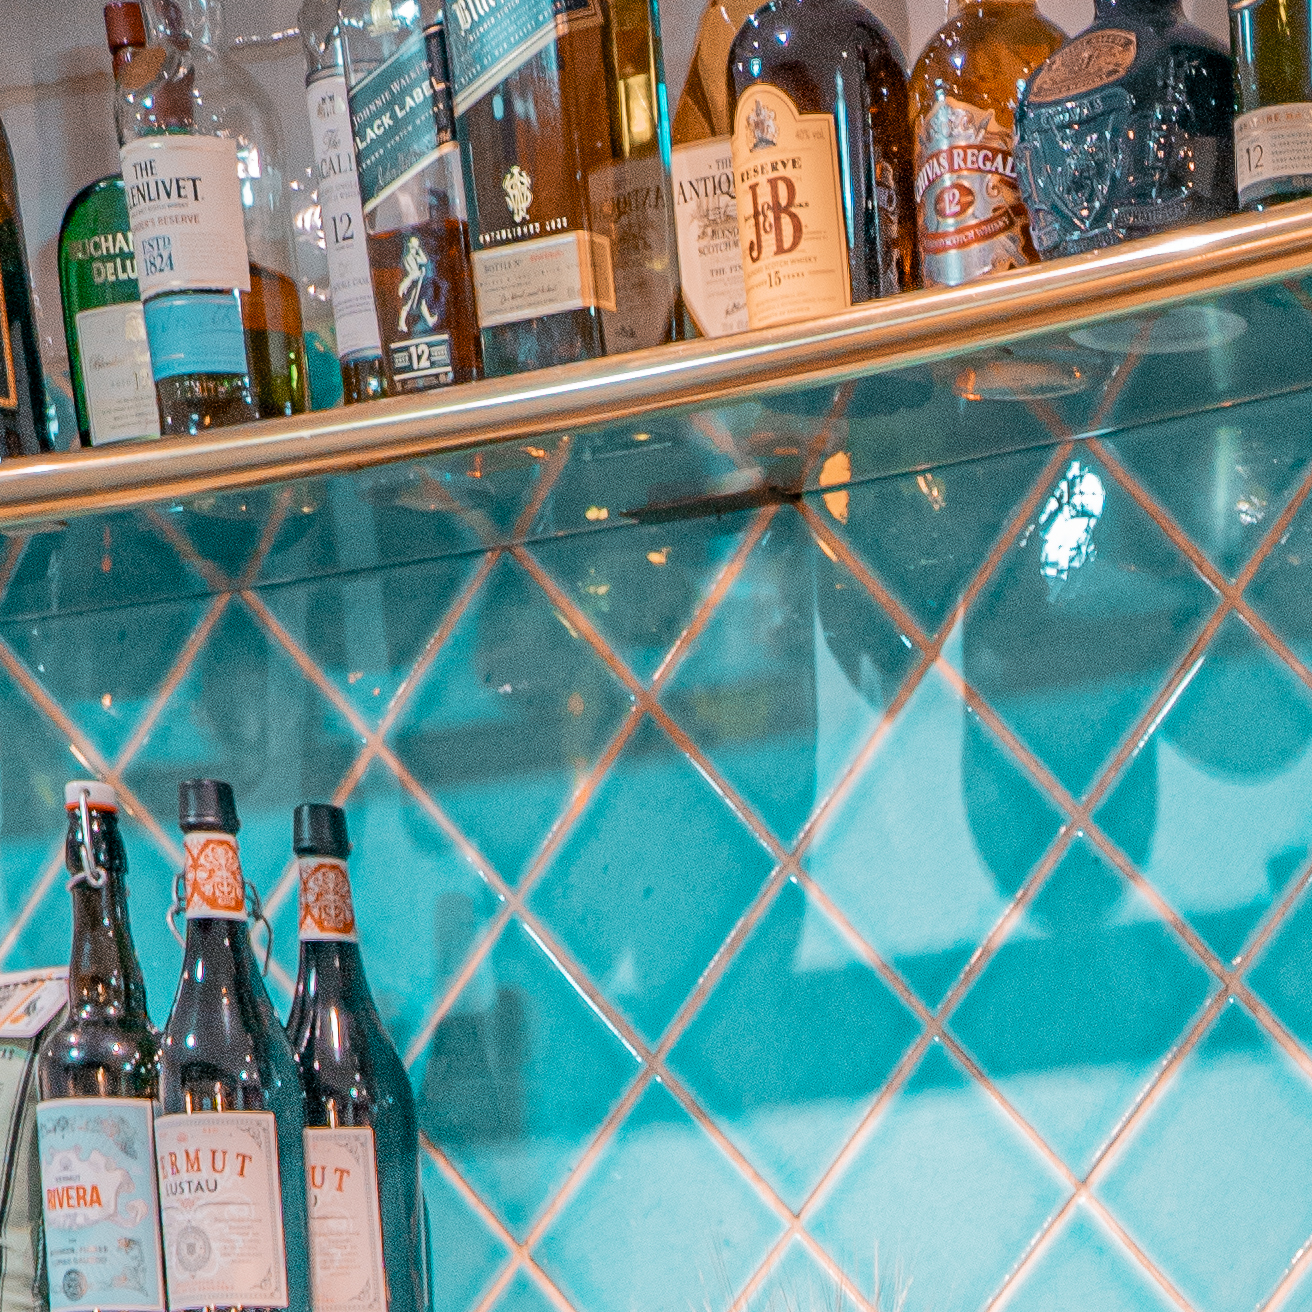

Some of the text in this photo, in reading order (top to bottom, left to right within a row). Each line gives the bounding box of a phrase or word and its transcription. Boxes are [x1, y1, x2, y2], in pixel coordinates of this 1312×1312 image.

[353, 90, 392, 131] JOHNNIE
[132, 158, 158, 180] THE
[740, 156, 803, 183] RESERVE
[952, 147, 1018, 179] REGAL
[1245, 144, 1264, 173] 12
[676, 170, 736, 206] ANTIQ
[943, 187, 961, 216] 12
[332, 212, 354, 243] 12
[748, 175, 804, 264] J&B
[144, 250, 175, 277] 1824
[767, 270, 782, 288] 15
[408, 343, 431, 370] 12
